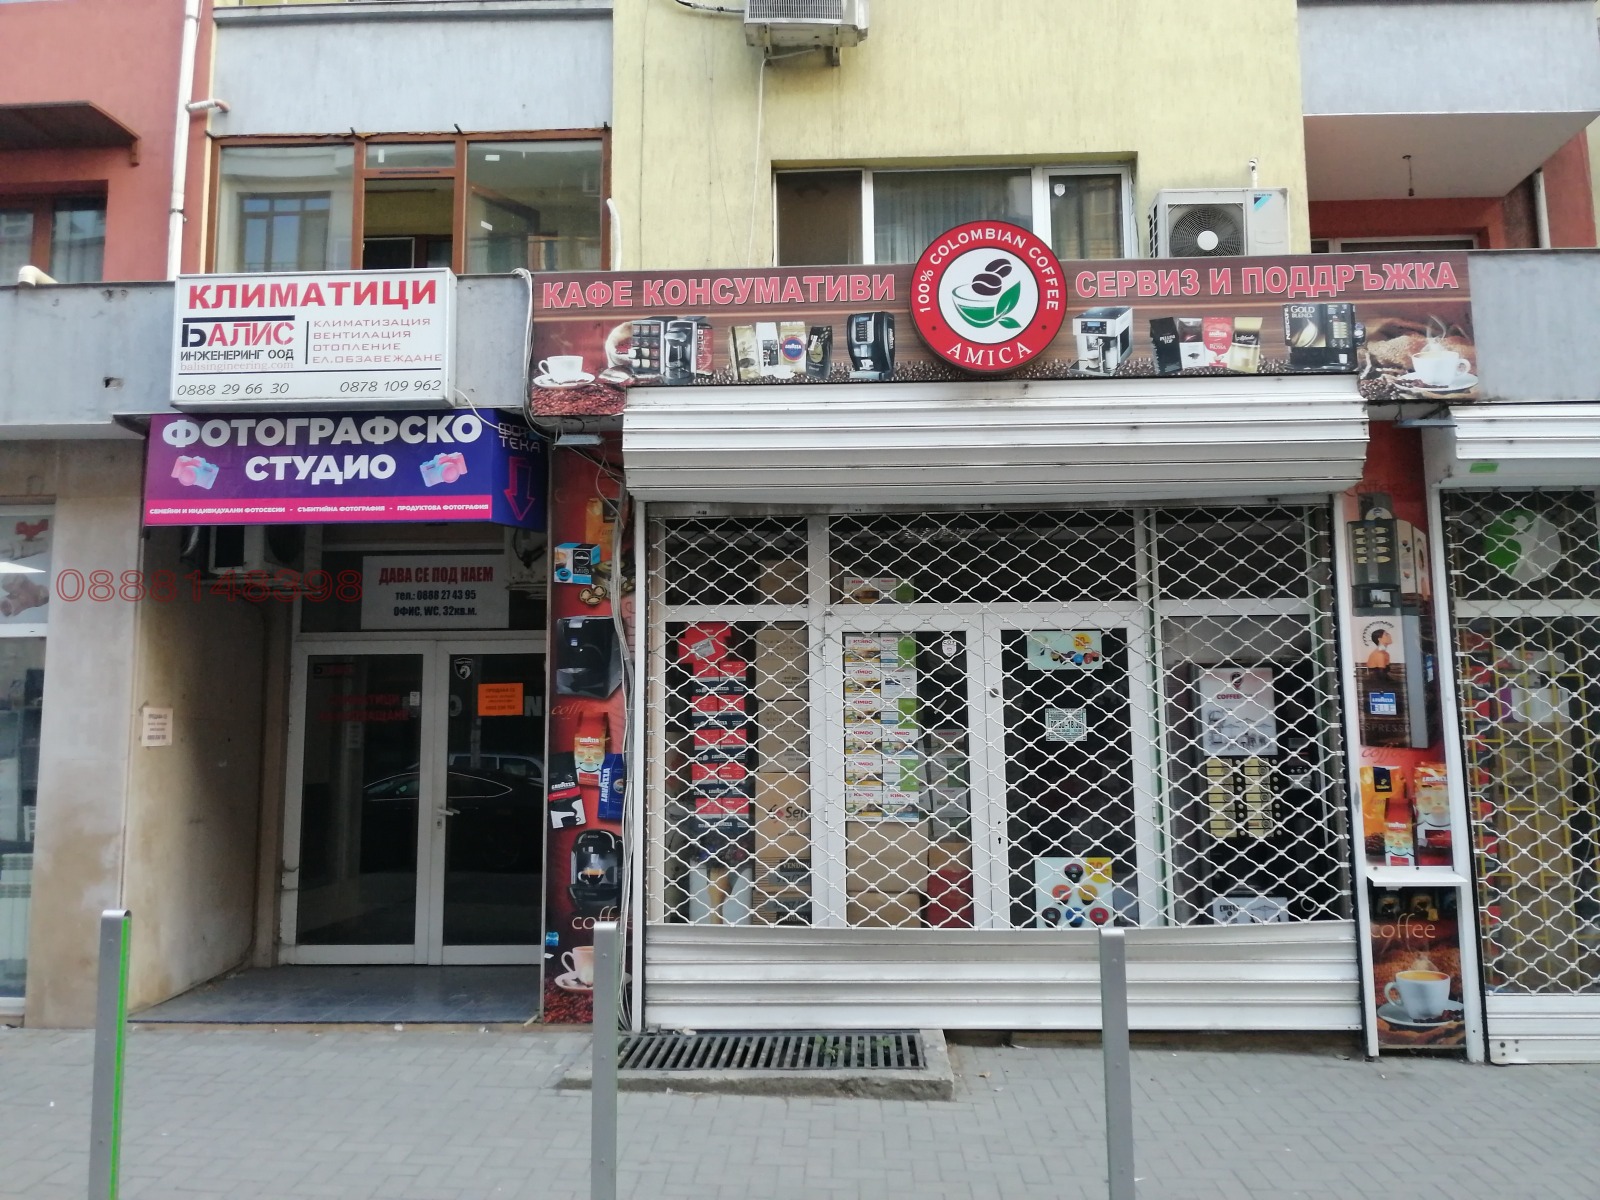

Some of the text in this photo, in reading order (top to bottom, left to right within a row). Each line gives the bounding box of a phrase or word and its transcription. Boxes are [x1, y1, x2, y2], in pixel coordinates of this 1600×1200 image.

[918, 228, 1060, 313] 100% COLOMBIAN COFFEE
[1075, 261, 1459, 299] СЕРВИЗ И ПОДДРЪЖКА
[188, 279, 437, 310] КЛИМАТИЦИ
[542, 273, 896, 308] КАФЕ КОНСУМАТИВИ
[181, 315, 295, 348] БАЛИС
[313, 318, 431, 328] КЛИМАТИЗАЦИЯ
[313, 330, 411, 340] ВЕНТИЛАЦИЯ
[180, 349, 294, 361] ИНЖЕНЕРИНГ ООД
[313, 343, 401, 352] ОТОПЛЕНИЕ
[946, 341, 1033, 366] AMICA
[177, 382, 290, 396] 0888 29 66 30
[339, 379, 442, 392] 0878 109 962
[162, 414, 483, 447] ФОТОГРАФСКО
[245, 454, 397, 485] СТУДИО
[397, 504, 442, 512] ПРОДУКТОВА
[378, 566, 494, 586] ДАВА СЕ ПОД НАЕМ
[440, 590, 451, 600] 27
[451, 590, 463, 600] 43
[464, 589, 477, 600] 95
[1370, 913, 1436, 939] coffee
